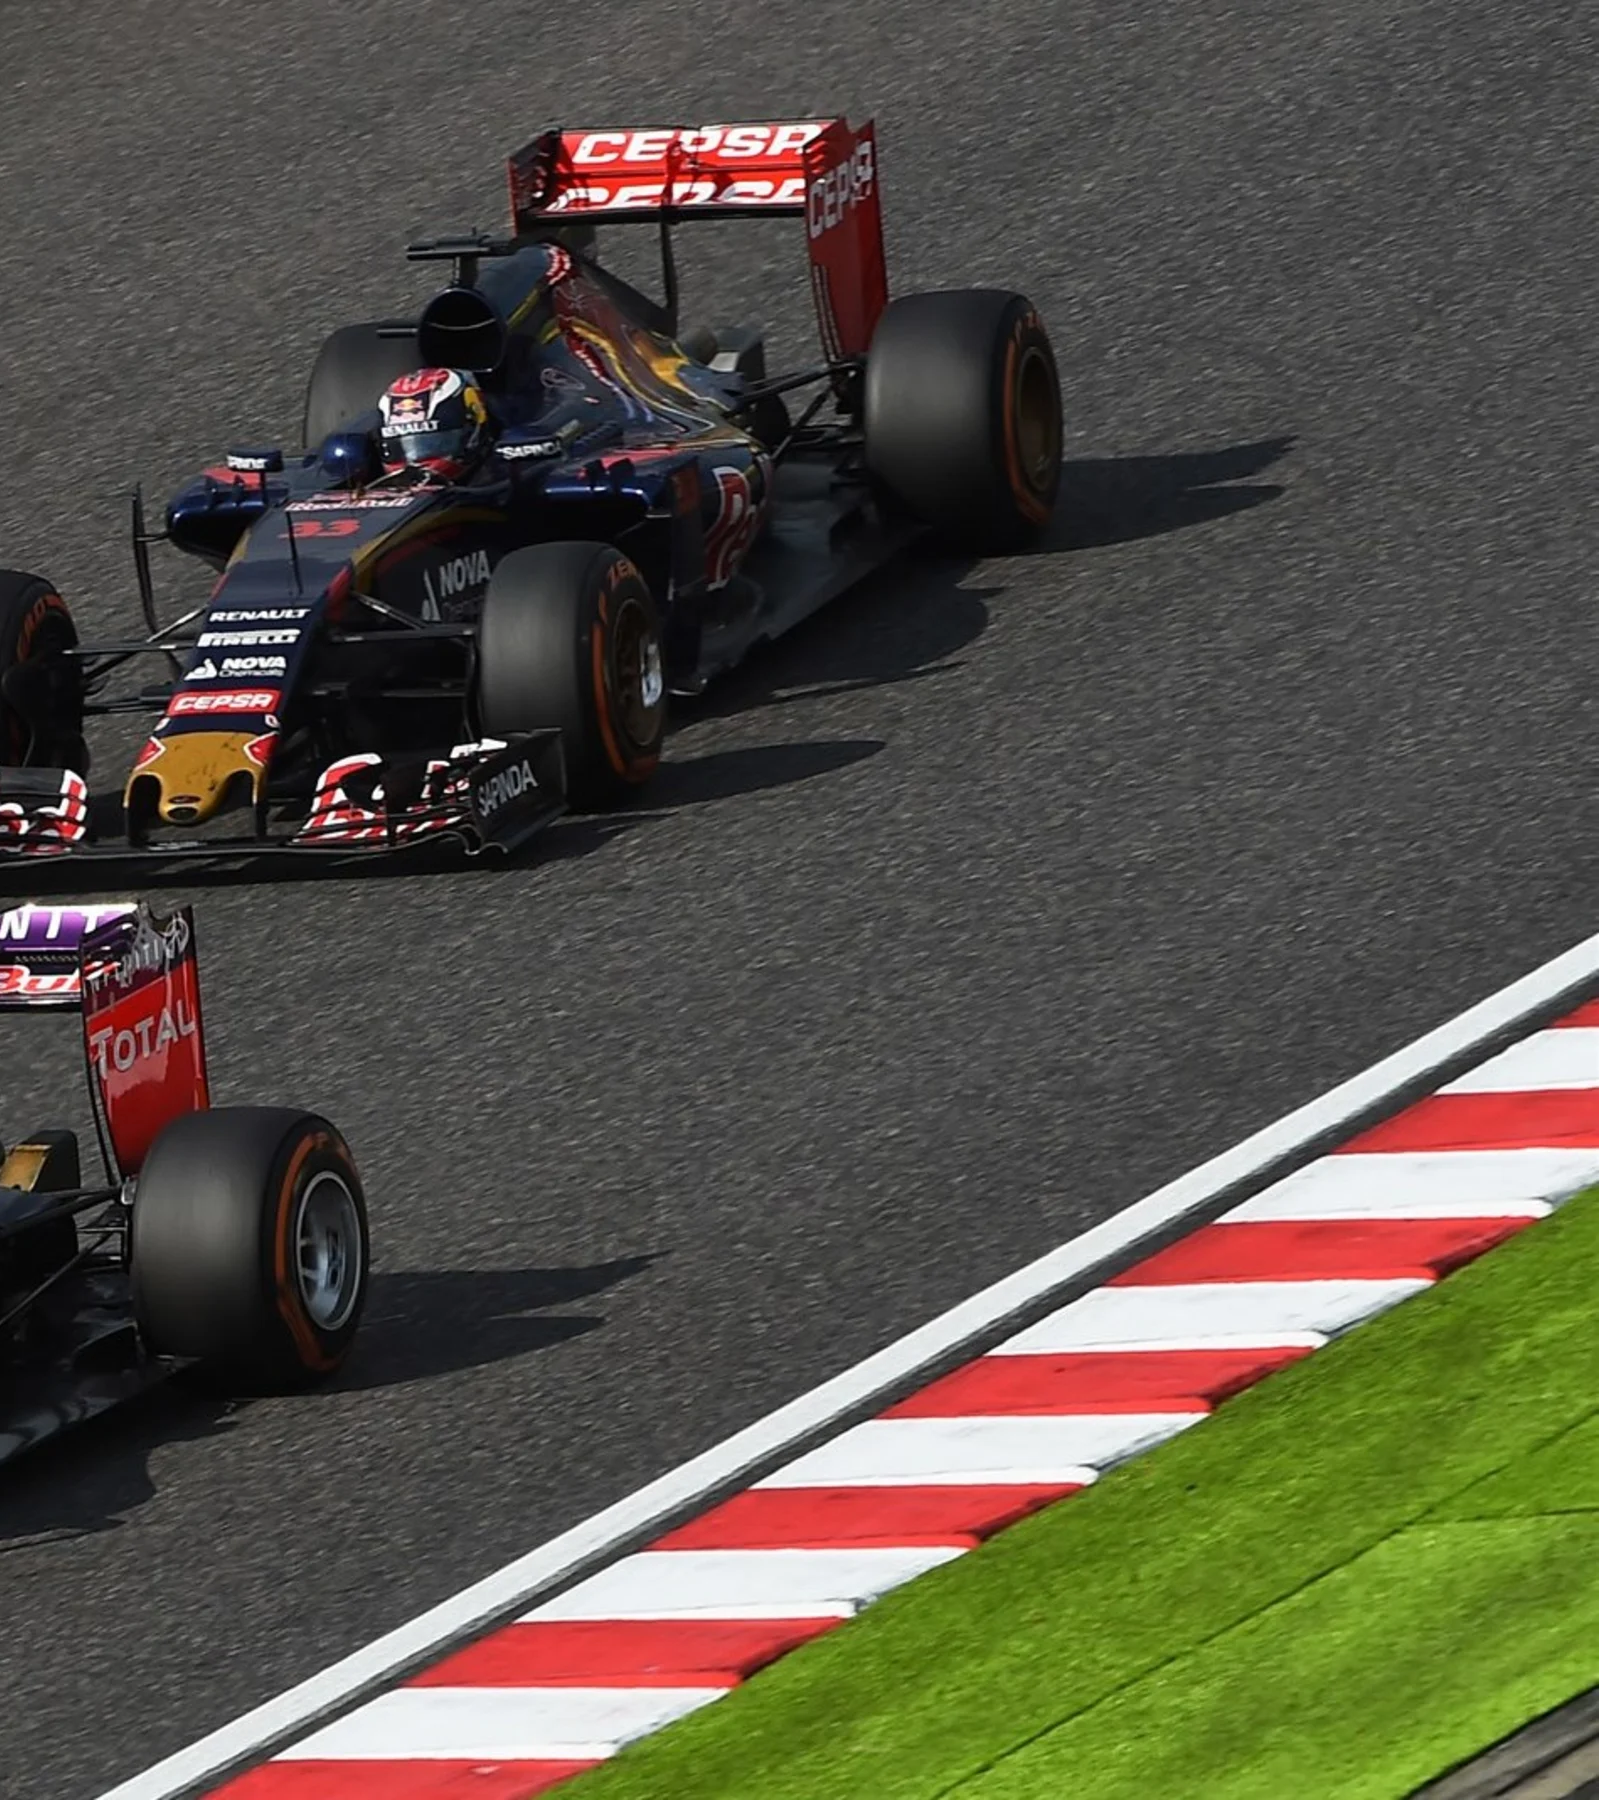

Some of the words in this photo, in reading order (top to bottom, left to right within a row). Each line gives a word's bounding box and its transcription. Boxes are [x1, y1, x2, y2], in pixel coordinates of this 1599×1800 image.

[278, 518, 361, 538] 33
[440, 550, 491, 597] NOVA
[209, 608, 311, 622] RENAULT
[221, 656, 286, 669] NOVA
[174, 694, 273, 711] CEPSA
[478, 760, 538, 817] SAPINDA
[90, 999, 197, 1080] TOTAL
